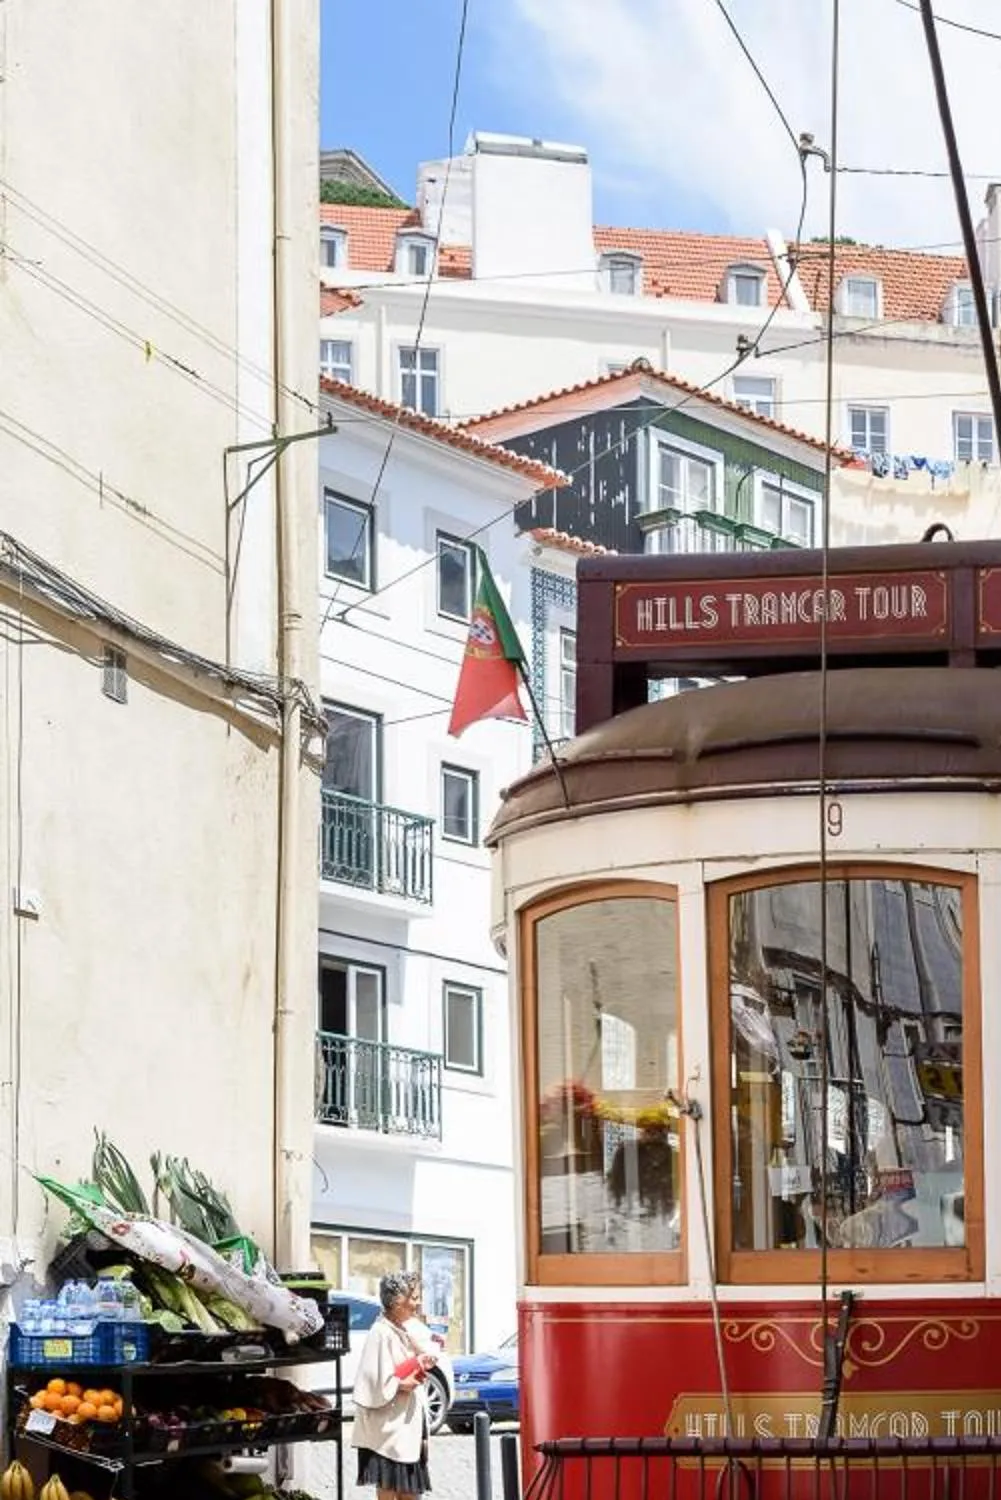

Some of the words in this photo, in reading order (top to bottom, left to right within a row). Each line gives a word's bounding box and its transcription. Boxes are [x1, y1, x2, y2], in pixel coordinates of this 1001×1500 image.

[636, 594, 719, 632] HILLS
[725, 589, 847, 628] TRAMCAR
[855, 584, 928, 620] TOUR
[827, 802, 843, 837] 9
